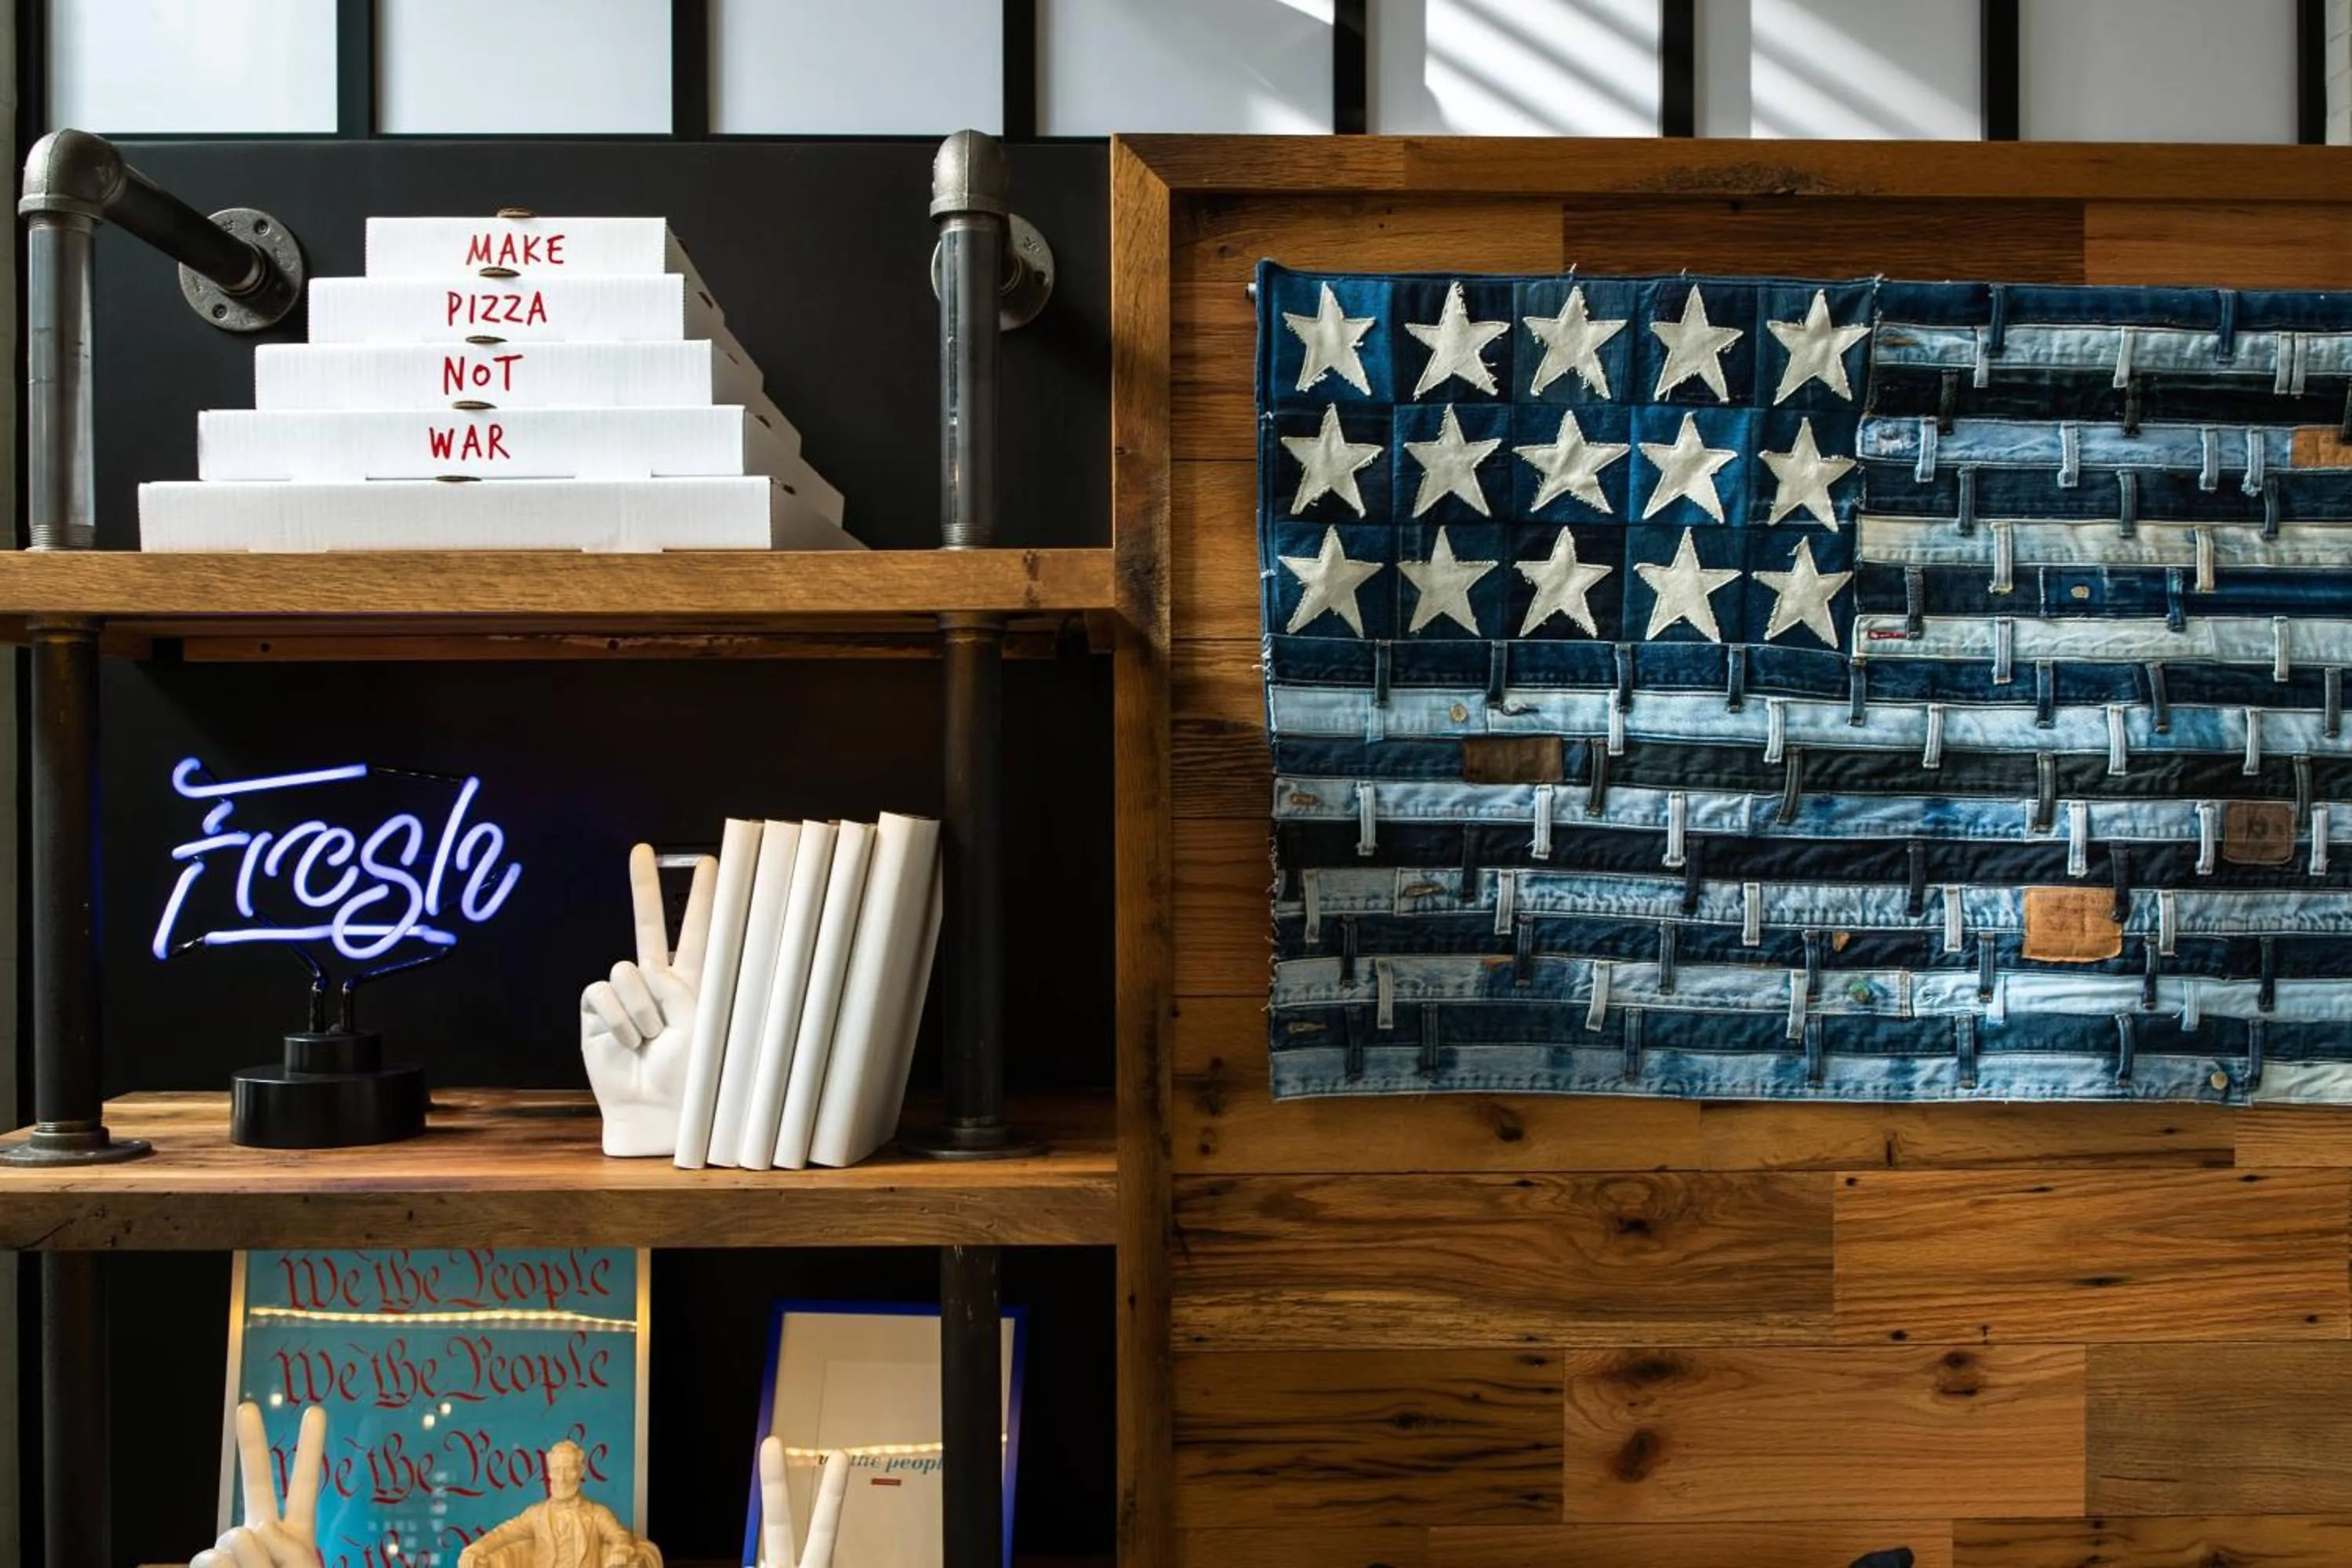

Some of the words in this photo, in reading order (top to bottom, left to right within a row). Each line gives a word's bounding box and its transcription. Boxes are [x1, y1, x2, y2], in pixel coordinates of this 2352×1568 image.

[465, 232, 565, 267] MAKE
[447, 290, 548, 327] PIZZA
[429, 423, 511, 461] WAR
[153, 757, 523, 960] Fresh
[278, 1250, 362, 1311] We
[373, 1248, 440, 1315] the
[446, 1248, 611, 1312] People
[271, 1342, 361, 1406] We
[372, 1338, 437, 1409] the
[443, 1330, 609, 1407] People
[368, 1432, 434, 1504] the
[443, 1422, 608, 1498] Peoe
[885, 1456, 943, 1475] peopl
